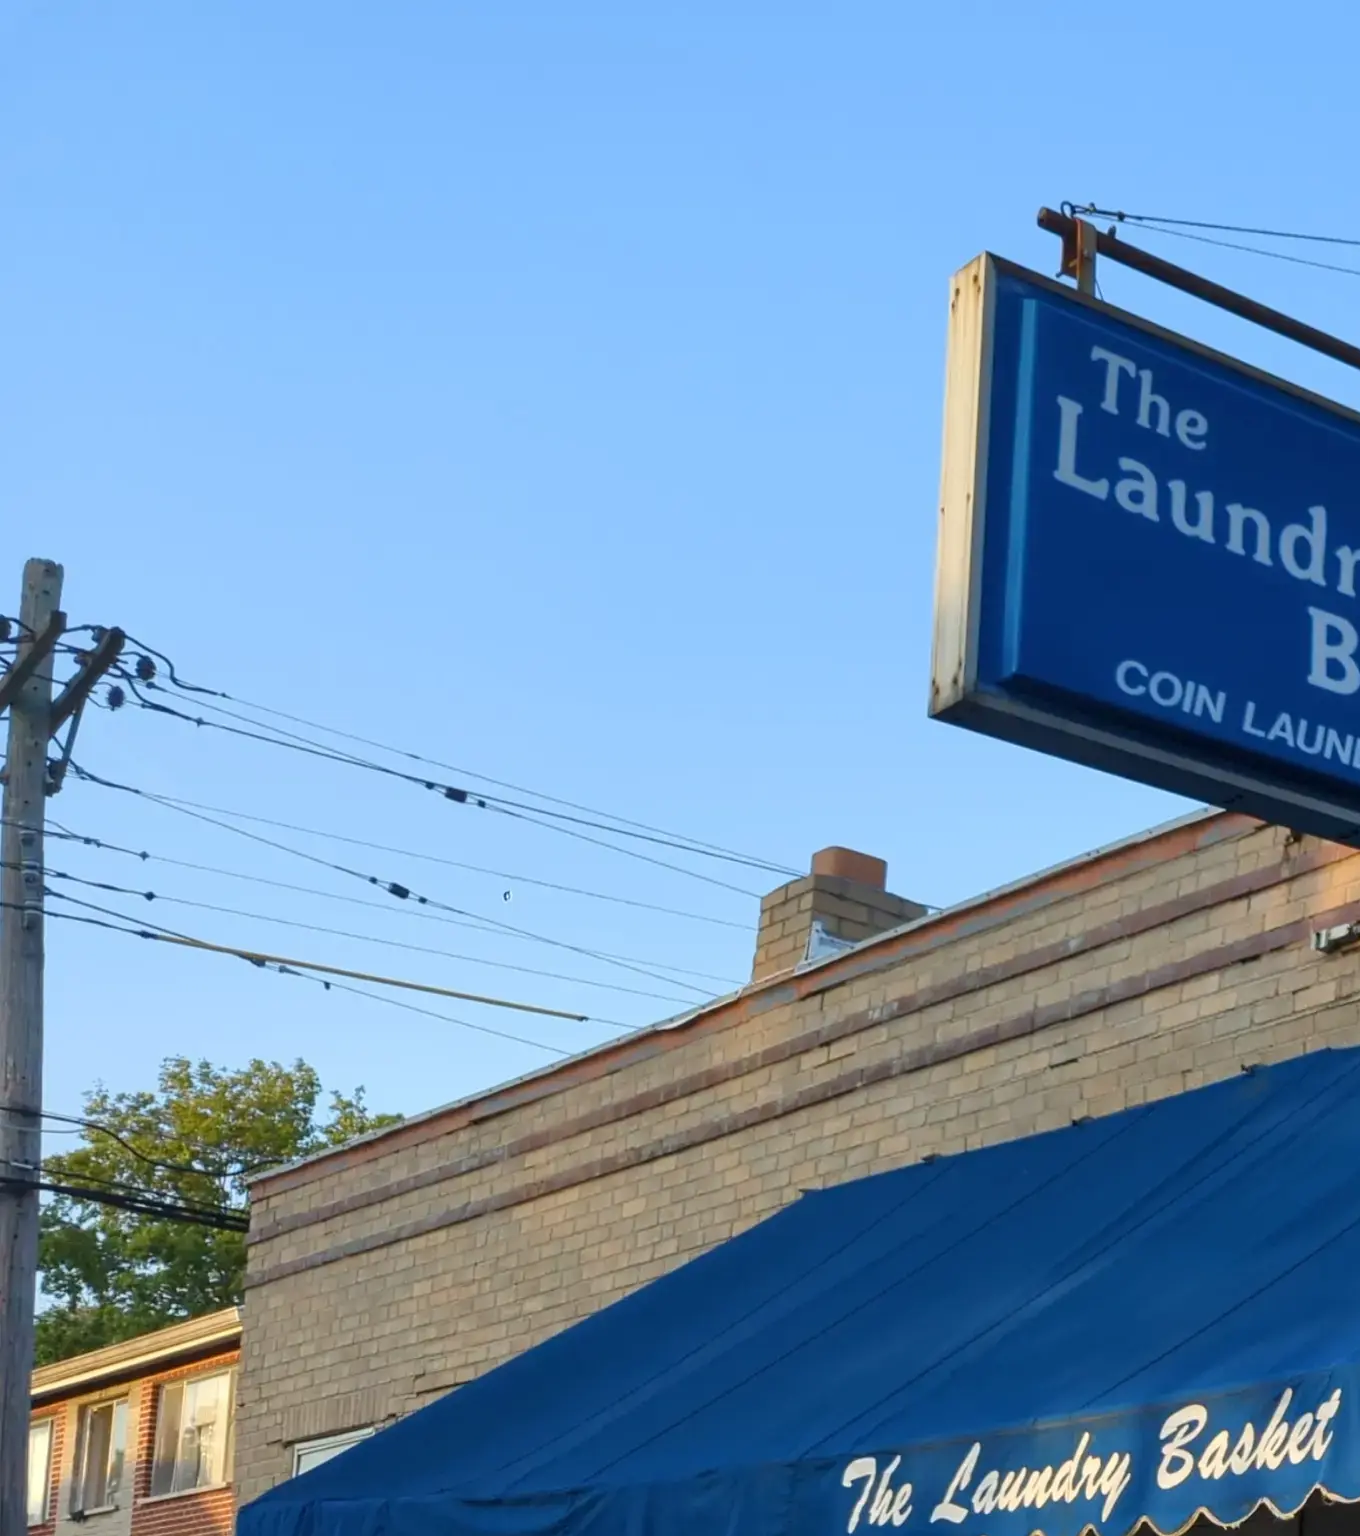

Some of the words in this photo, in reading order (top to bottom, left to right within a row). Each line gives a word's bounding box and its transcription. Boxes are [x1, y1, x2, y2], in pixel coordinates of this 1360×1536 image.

[1091, 346, 1208, 450] The
[1115, 660, 1226, 725] COIN
[842, 1454, 914, 1535] The
[930, 1432, 1131, 1524] Laundry
[1156, 1387, 1342, 1490] Basket
